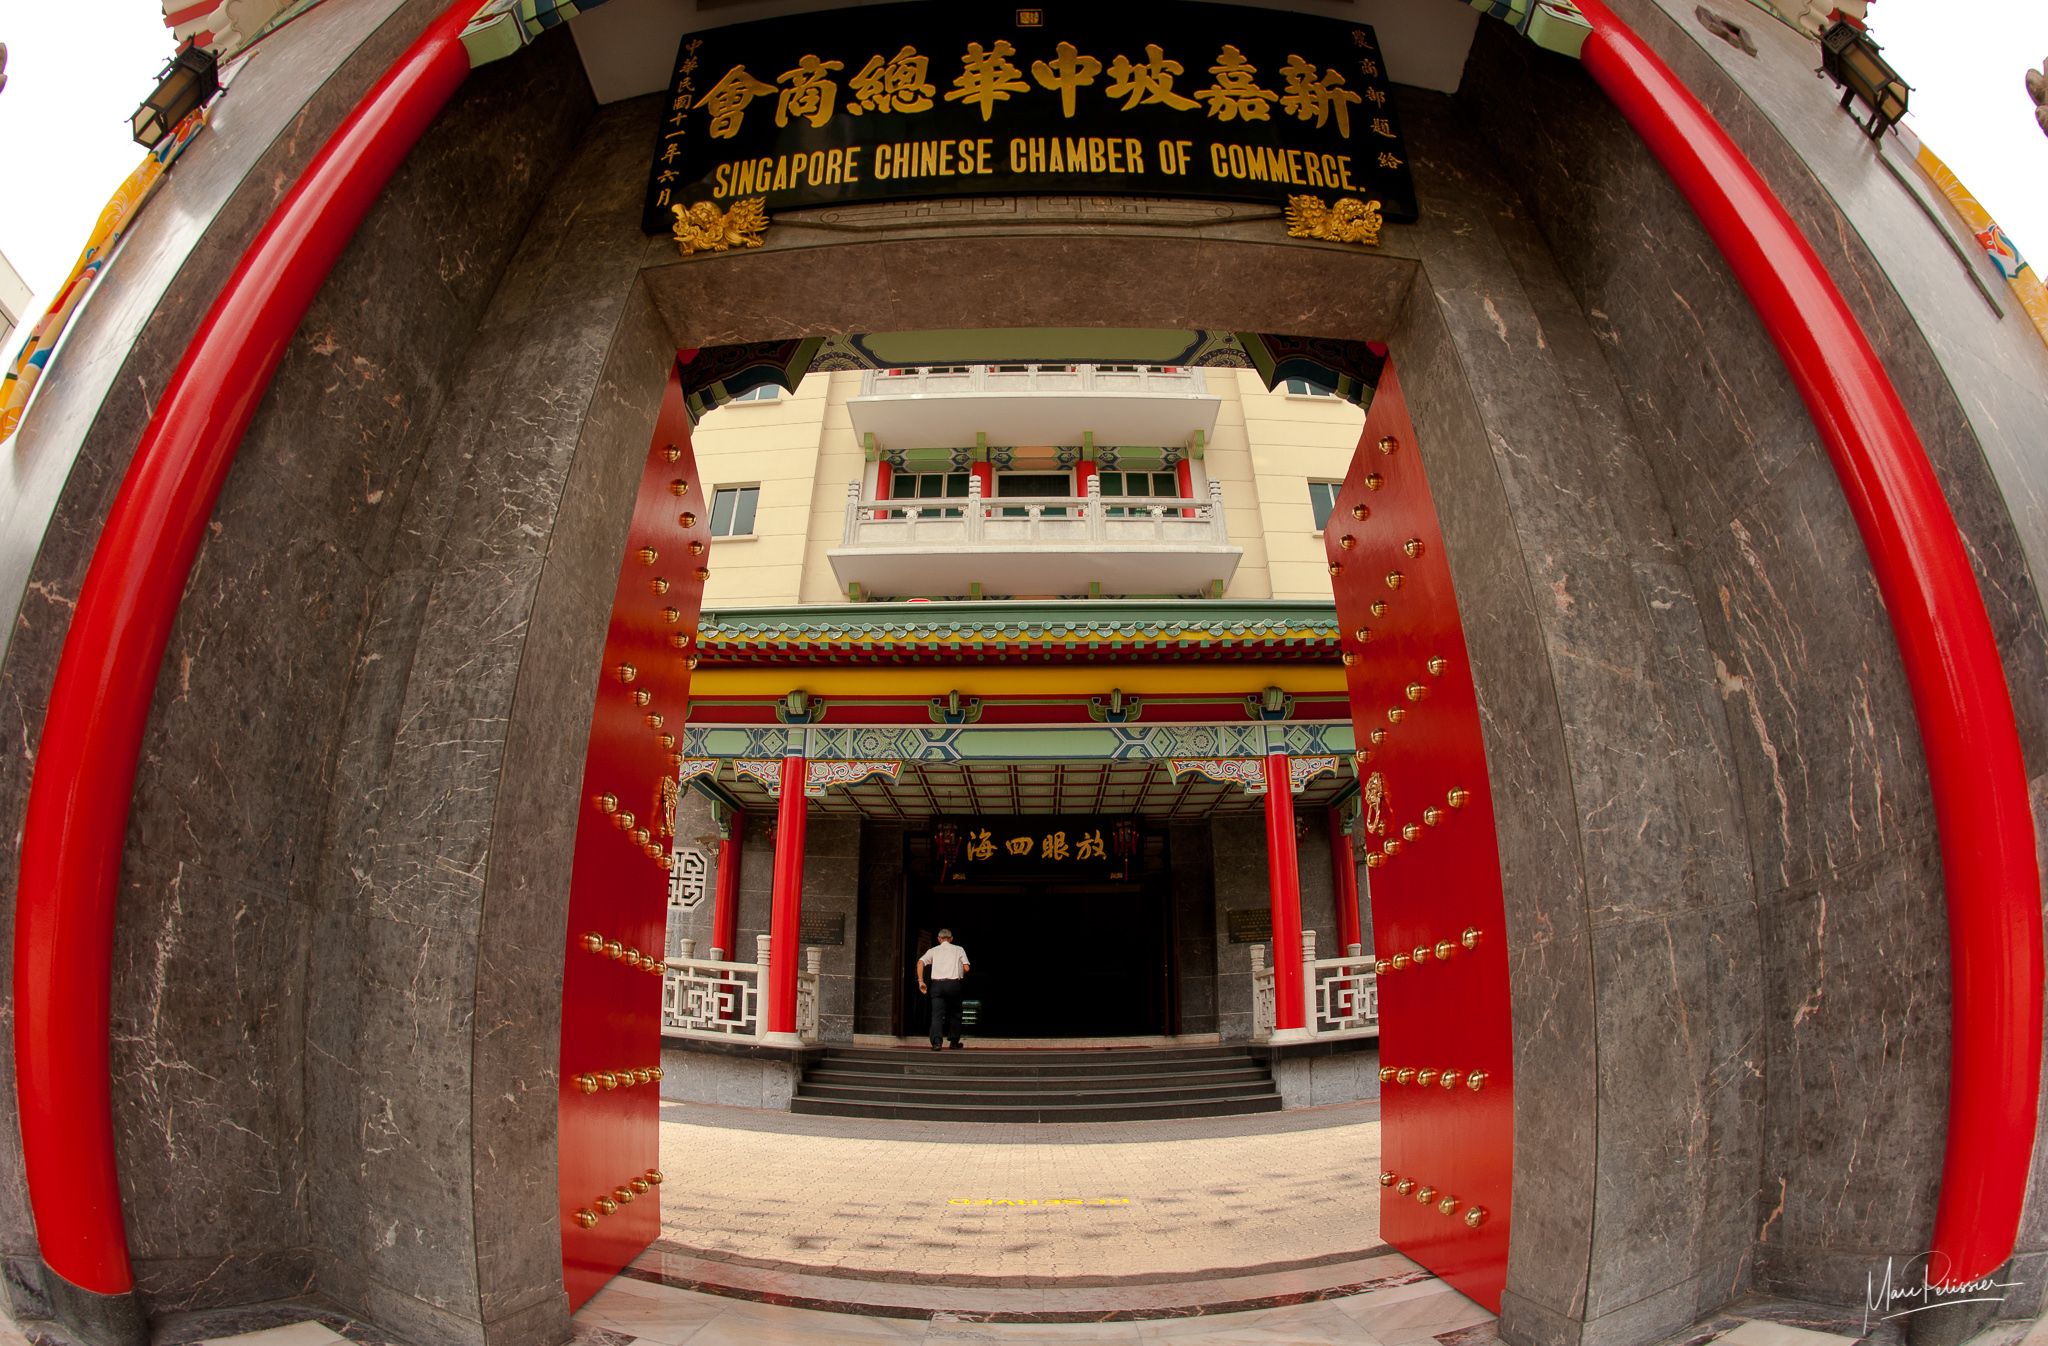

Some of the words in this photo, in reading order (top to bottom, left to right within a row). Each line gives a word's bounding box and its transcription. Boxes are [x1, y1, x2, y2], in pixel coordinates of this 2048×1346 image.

[656, 39, 703, 207] 中華民國十一年六月
[693, 40, 1362, 139] 新嘉坡中華總商會
[713, 146, 861, 199] SINGAPORE
[874, 138, 993, 180] CHINESE
[1010, 137, 1145, 174] CHAMBER
[1159, 139, 1193, 176] OF
[1210, 143, 1366, 192] COMMERCE.
[966, 828, 1107, 861] 放眼四海
